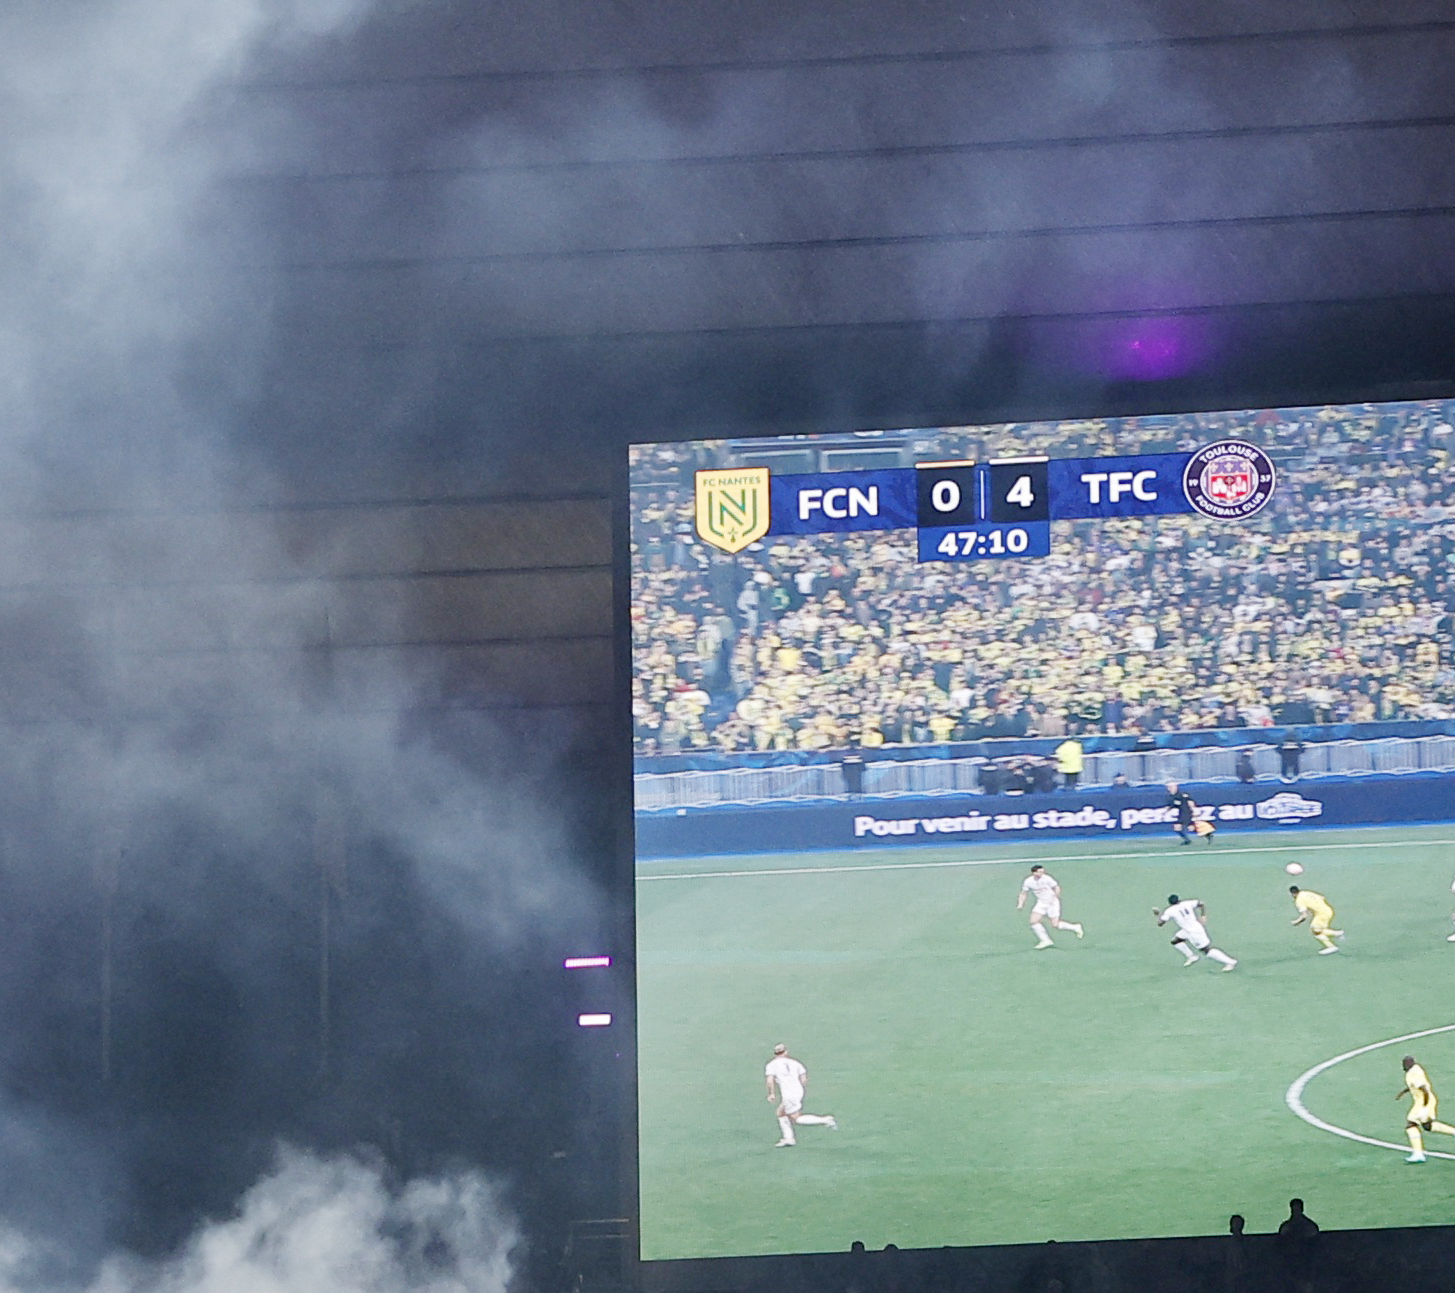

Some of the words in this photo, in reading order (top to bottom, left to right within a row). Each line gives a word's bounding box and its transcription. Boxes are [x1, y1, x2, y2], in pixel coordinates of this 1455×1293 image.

[1199, 445, 1259, 463] TOULOUSE
[703, 478, 716, 487] FC
[718, 476, 761, 486] NANTES
[931, 480, 960, 512] 0
[1006, 476, 1034, 507] 4
[1081, 470, 1157, 504] TFC
[798, 486, 878, 520] FCN
[1195, 494, 1242, 515] FOOTBALL
[1241, 491, 1265, 511] CLUB
[938, 528, 1028, 556] 47:10
[854, 815, 920, 837] Pour
[921, 810, 992, 833] venir
[993, 813, 1030, 830] au
[1032, 805, 1117, 829] stade,
[1218, 803, 1254, 820] au
